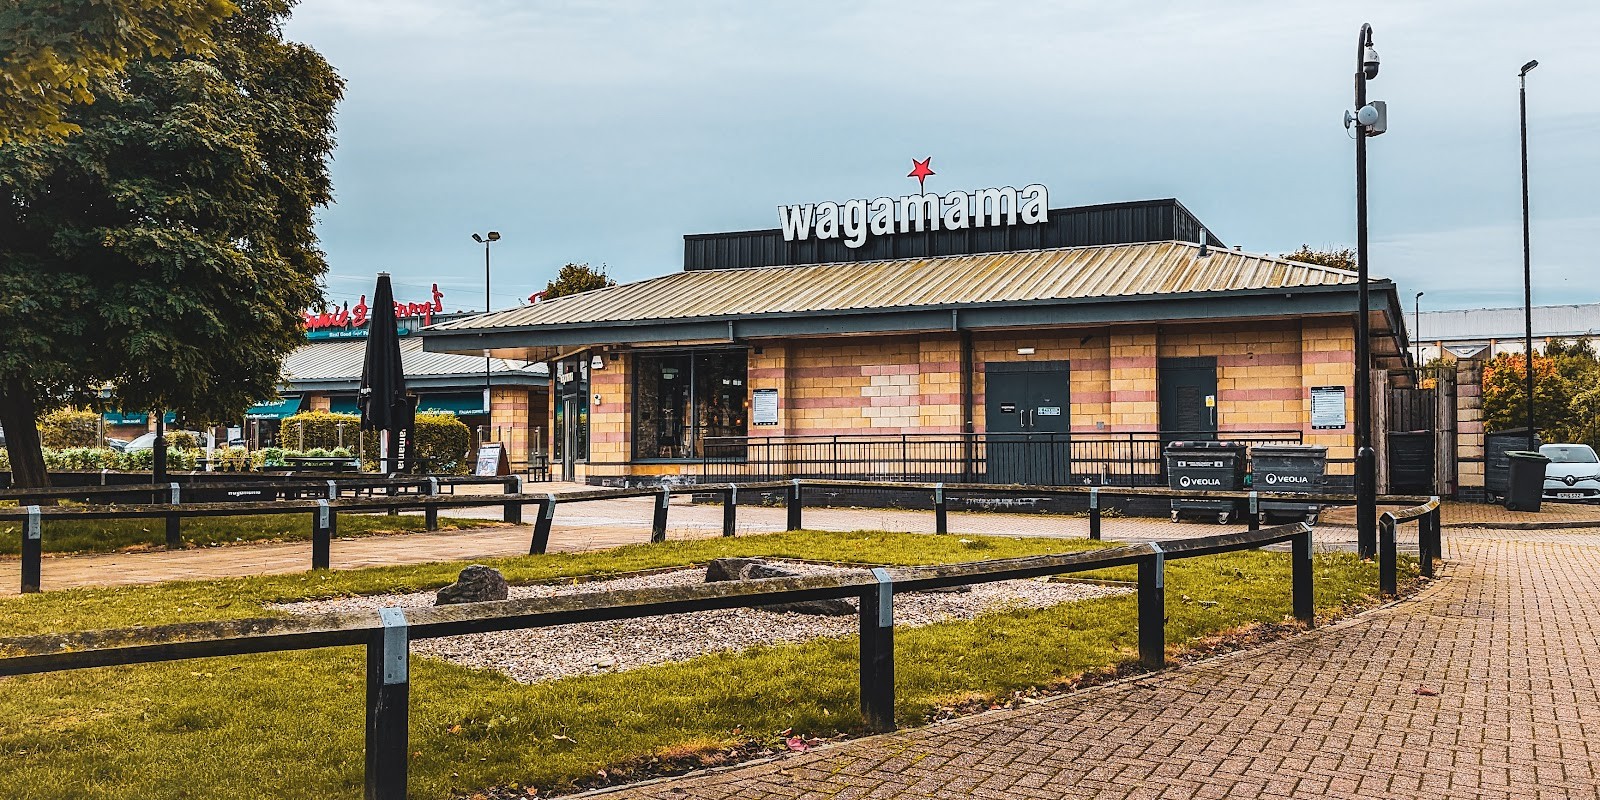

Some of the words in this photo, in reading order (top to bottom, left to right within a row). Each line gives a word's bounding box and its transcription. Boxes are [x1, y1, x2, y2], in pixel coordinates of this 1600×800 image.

[777, 183, 1049, 249] wagamama
[1191, 478, 1221, 486] VEOLIA
[1277, 475, 1308, 483] VEOLIA
